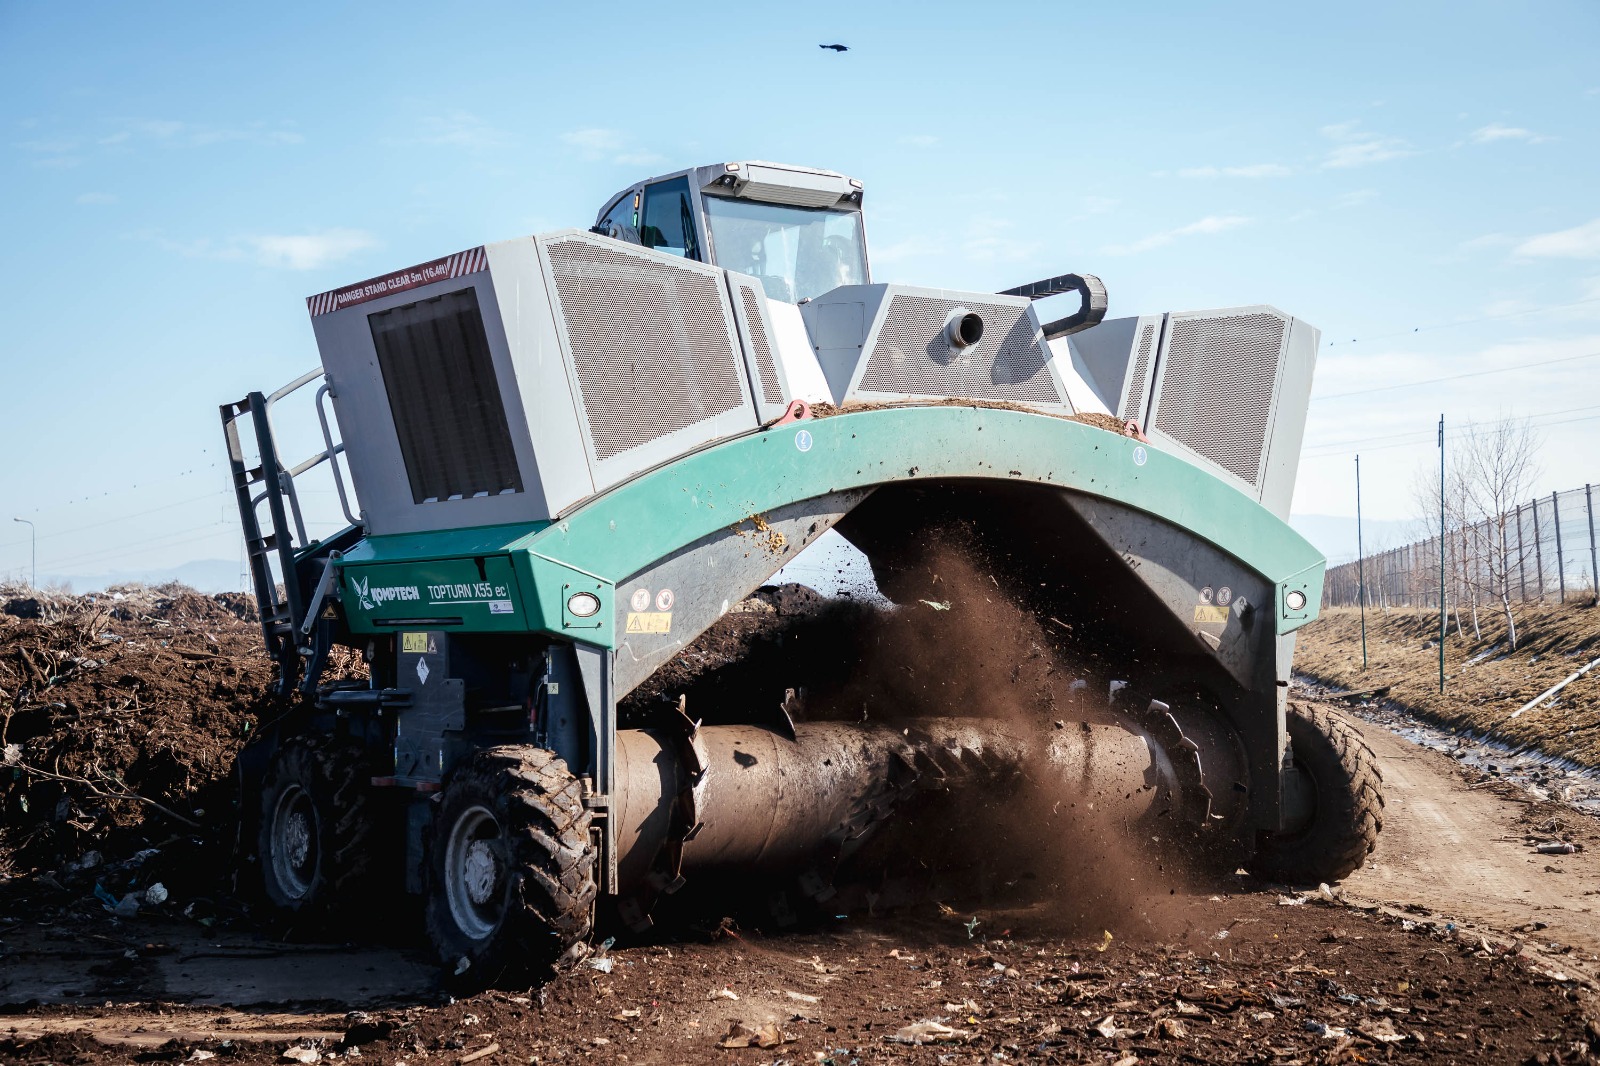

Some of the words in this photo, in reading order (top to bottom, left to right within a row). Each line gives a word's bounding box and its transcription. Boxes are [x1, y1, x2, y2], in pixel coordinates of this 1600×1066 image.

[338, 288, 364, 303] DANGER
[364, 282, 387, 296] STAND
[388, 274, 410, 289] CLEAR
[410, 272, 422, 282] 5m
[422, 263, 448, 281] (16.4ft)
[370, 586, 420, 606] KOMPTECH
[427, 583, 472, 599] TOPTURN
[472, 583, 493, 598] X55
[495, 586, 506, 597] ec
